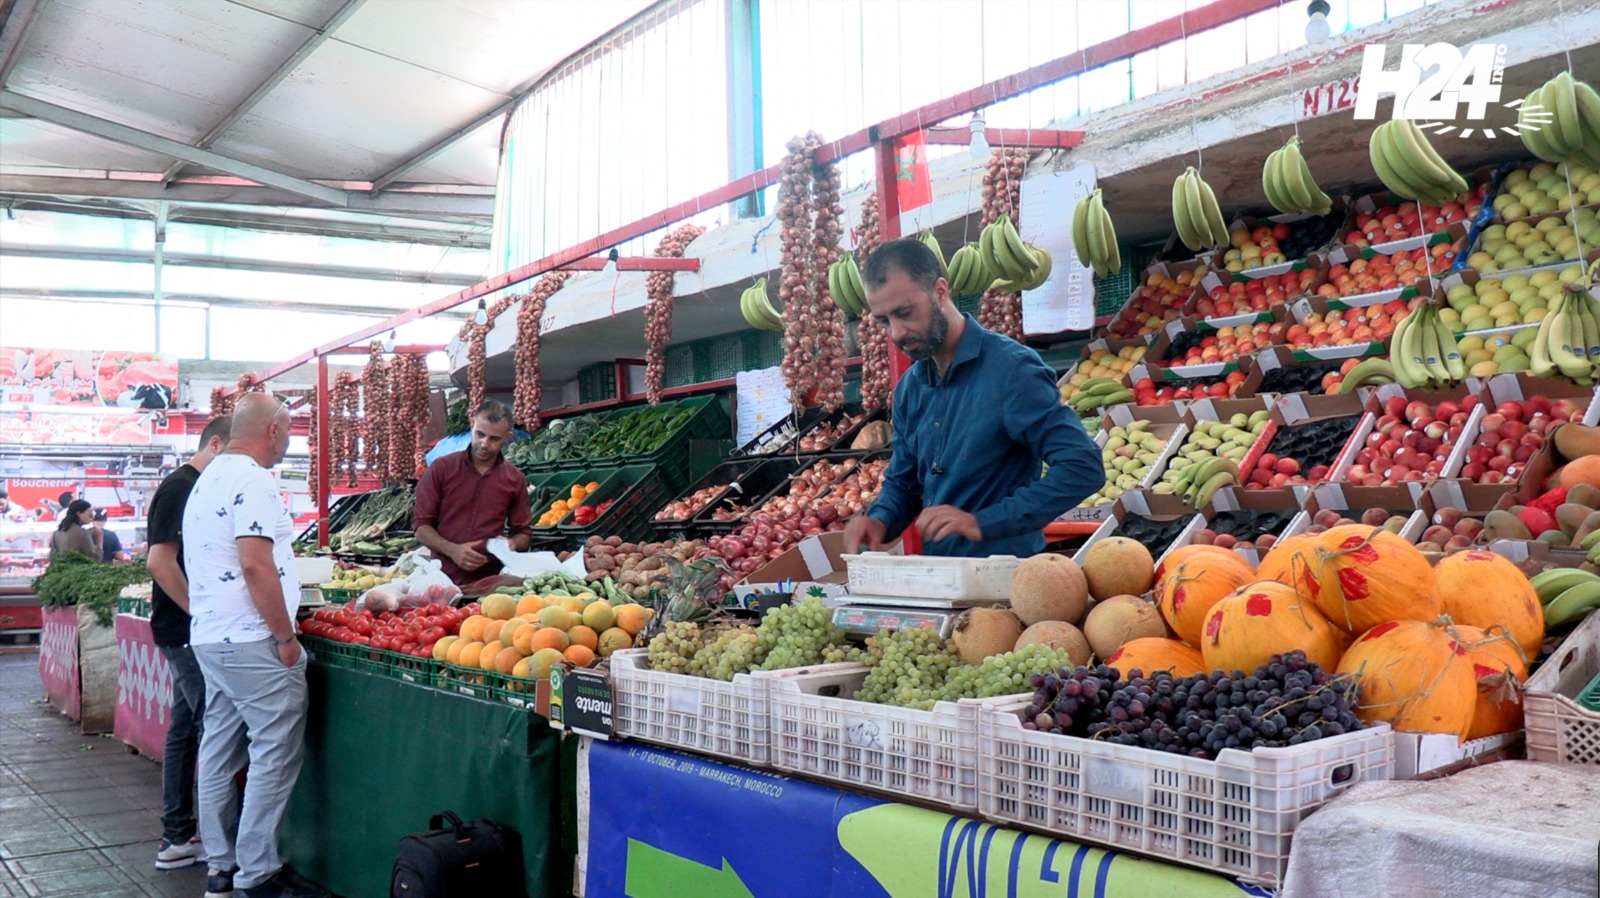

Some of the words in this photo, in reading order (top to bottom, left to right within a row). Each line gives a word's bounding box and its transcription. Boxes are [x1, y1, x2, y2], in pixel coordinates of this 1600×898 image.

[12, 478, 71, 488] Boucherie
[575, 696, 612, 715] mente
[628, 748, 637, 759] 14
[640, 751, 648, 761] 17
[647, 753, 677, 771] OCTOBER,
[676, 761, 695, 774] 2019
[699, 766, 742, 789] MARRAKECH,
[744, 778, 783, 798] MOROCCO
